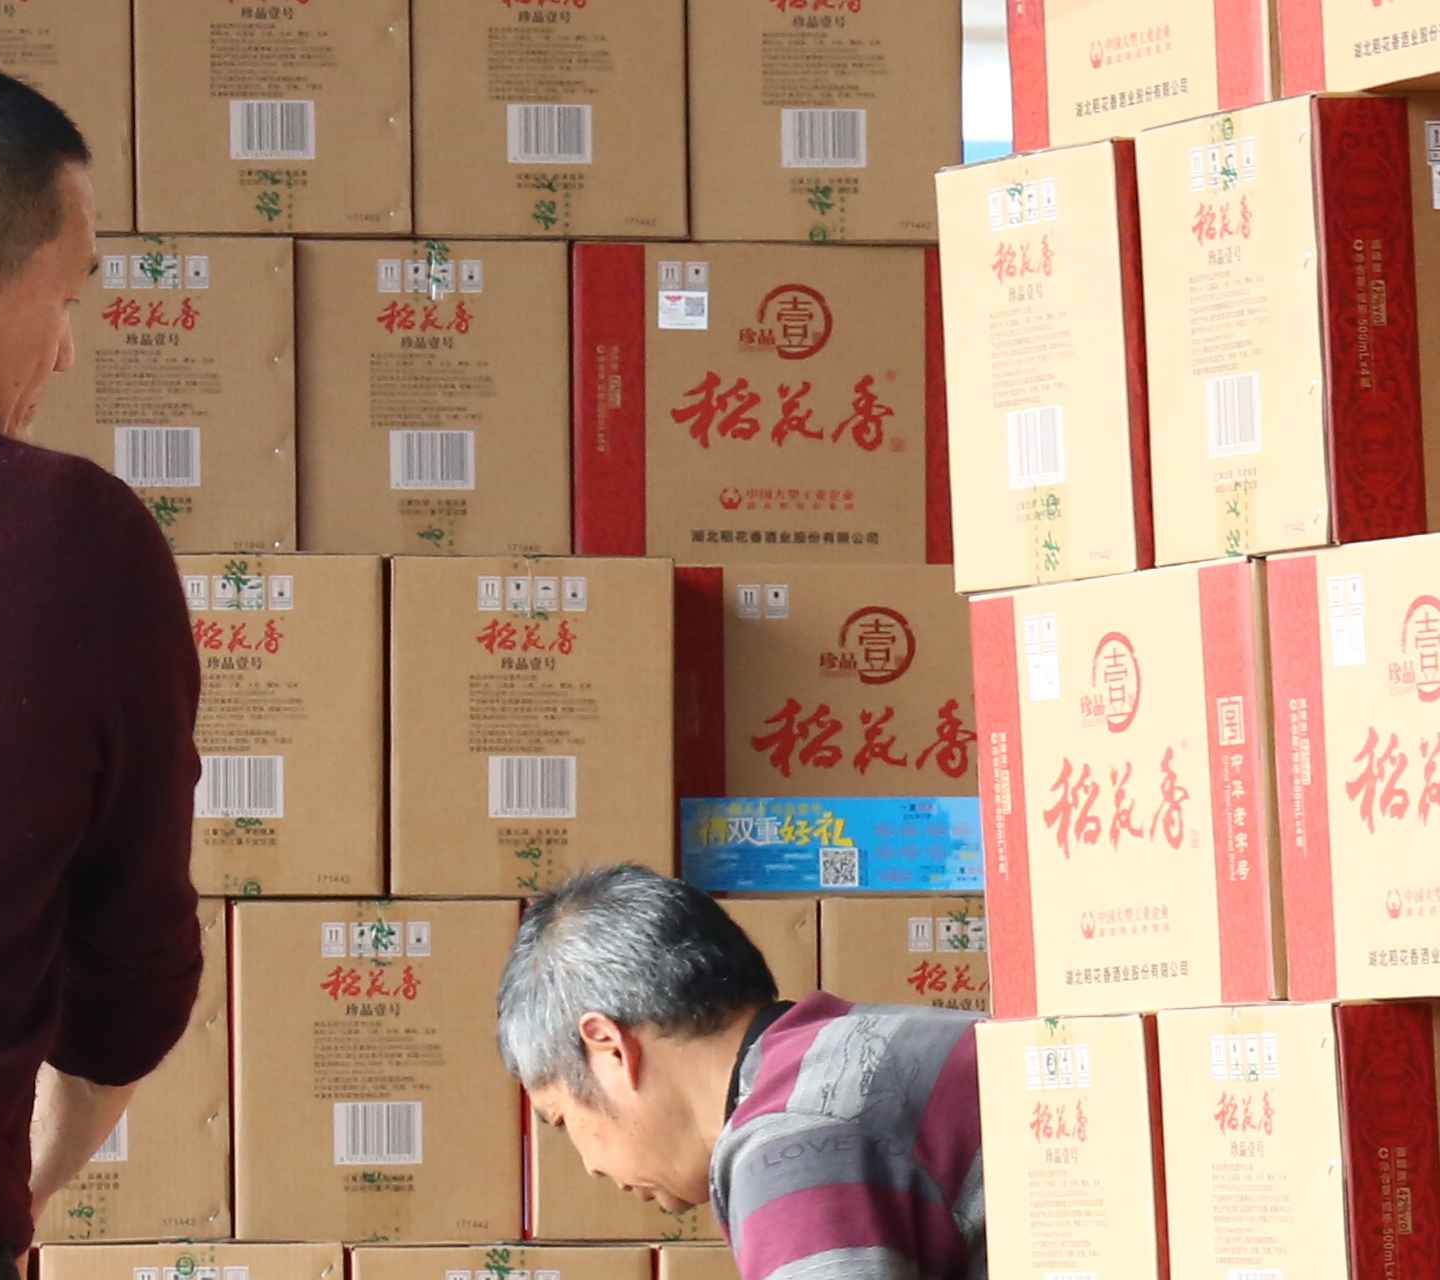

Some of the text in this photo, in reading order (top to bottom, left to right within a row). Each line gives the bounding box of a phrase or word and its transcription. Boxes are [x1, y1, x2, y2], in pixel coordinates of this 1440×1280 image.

[1190, 199, 1251, 242] 稻花香
[990, 238, 1054, 282] 稻花香
[376, 301, 473, 335] 稻花香
[671, 370, 895, 451] 稻花香
[475, 619, 577, 657] 稻花香
[751, 698, 976, 779] 稻花香
[1043, 745, 1190, 859] 稻花香
[1029, 1102, 1090, 1142] 稻花香
[1213, 1092, 1276, 1137] 稻花香
